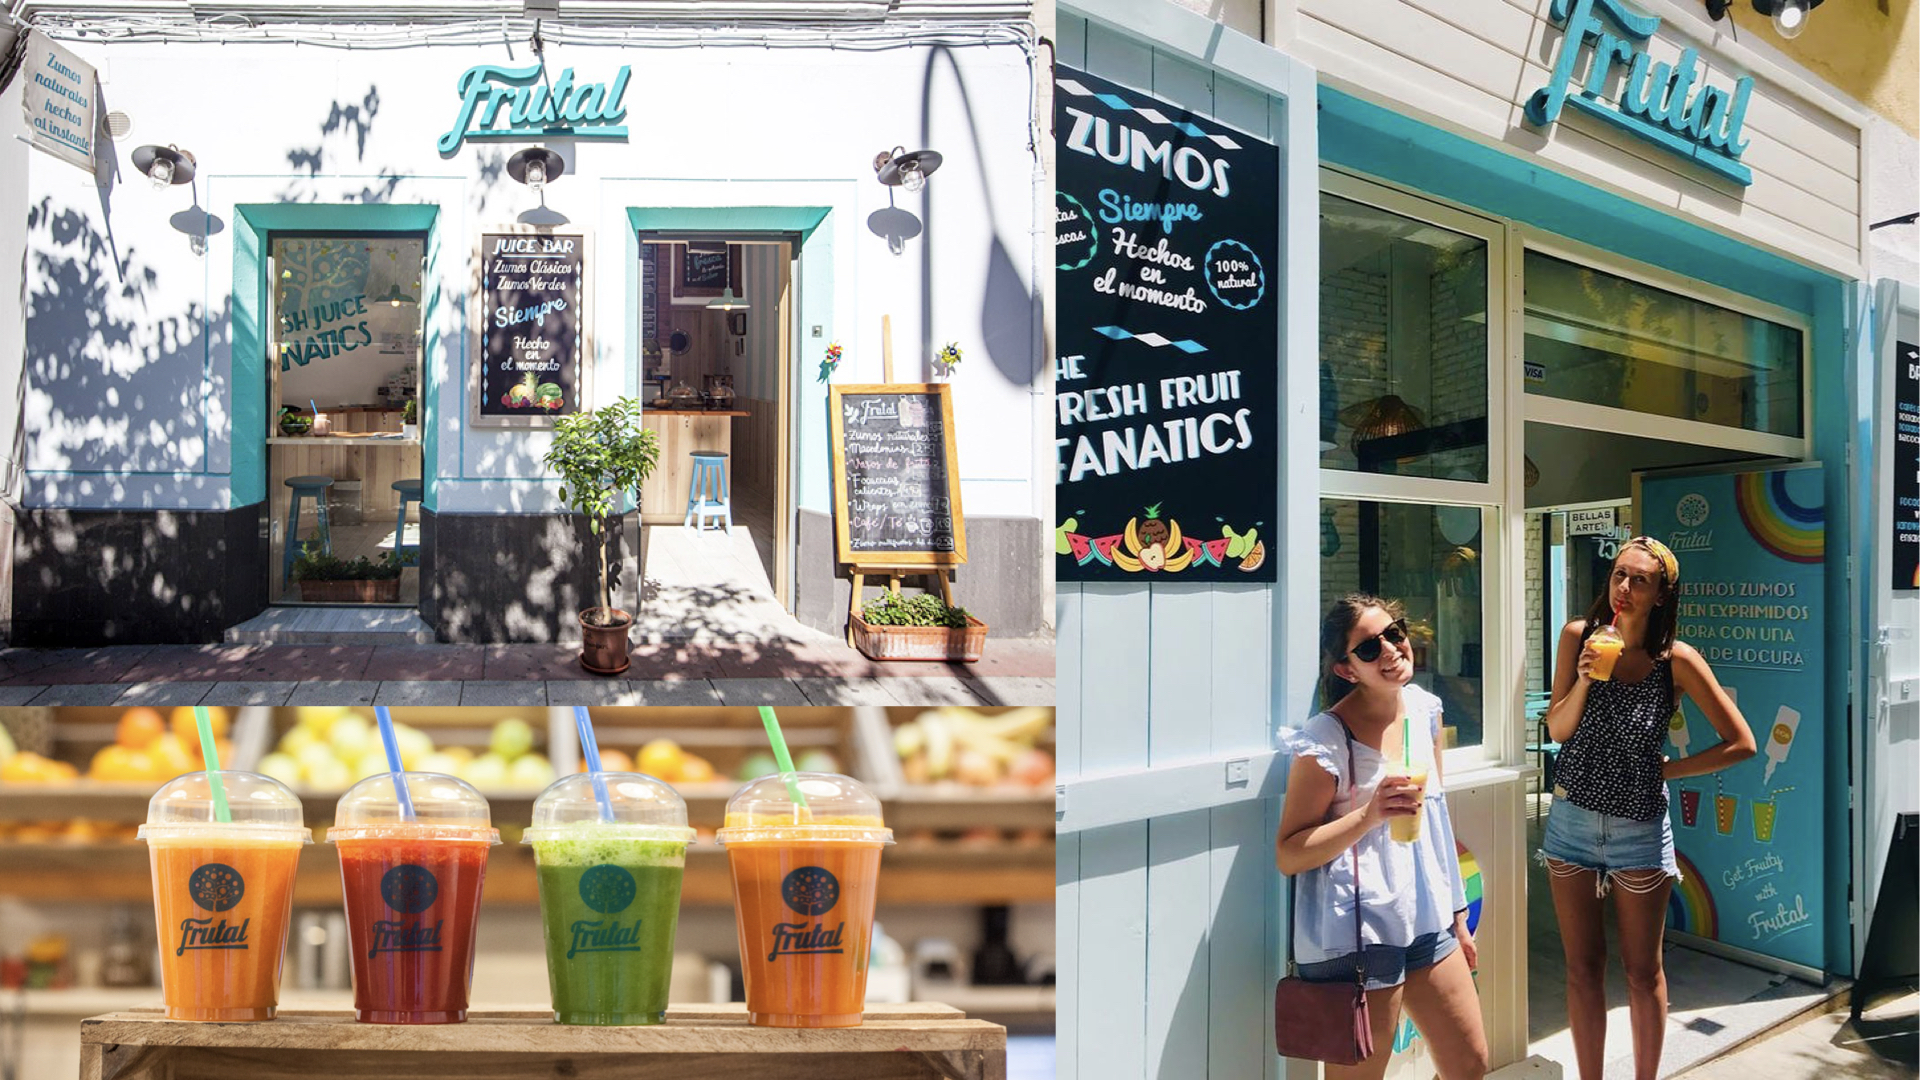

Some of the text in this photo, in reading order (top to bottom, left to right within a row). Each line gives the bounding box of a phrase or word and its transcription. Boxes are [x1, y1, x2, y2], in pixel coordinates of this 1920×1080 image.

[47, 52, 81, 84] Zumos
[1524, 0, 1755, 155] Frutal
[35, 72, 87, 108] naturales
[44, 98, 81, 126] hechos
[437, 64, 632, 157] Frutal
[34, 117, 89, 150] al instante
[1065, 106, 1231, 197] ZUMOS
[1098, 188, 1203, 234] Siempre
[493, 239, 574, 255] JUICE BAR
[1112, 227, 1194, 271] Hechos
[493, 259, 572, 274] Zumos Clásicos
[1140, 266, 1166, 284] en
[1215, 259, 1249, 273] 100%
[497, 275, 566, 290] Zumos Verdes
[1093, 267, 1207, 313] el momento
[1217, 272, 1257, 289] natural
[281, 294, 367, 333] SH JUICE
[495, 298, 567, 327] Siempre
[514, 335, 550, 350] Hecho
[525, 350, 541, 360] en
[501, 356, 560, 371] el momento
[1056, 355, 1087, 381] HE
[1524, 366, 1543, 378] VISA
[1056, 370, 1241, 425] RESH FRUIT
[1572, 511, 1611, 521] BELLAS
[1668, 530, 1713, 550] Frutal
[1740, 583, 1796, 597] ZUMOS
[1710, 604, 1809, 620] EXPRIMIDOS
[1676, 624, 1716, 639] HORA
[1720, 626, 1756, 641] CON
[1722, 852, 1784, 890] Get Fruity
[1755, 882, 1778, 902] with
[1747, 894, 1809, 940] Frutal
[176, 917, 250, 956] Frutal
[368, 919, 444, 959] Frutal
[567, 919, 642, 959] Frutal
[768, 921, 845, 962] Frutal
